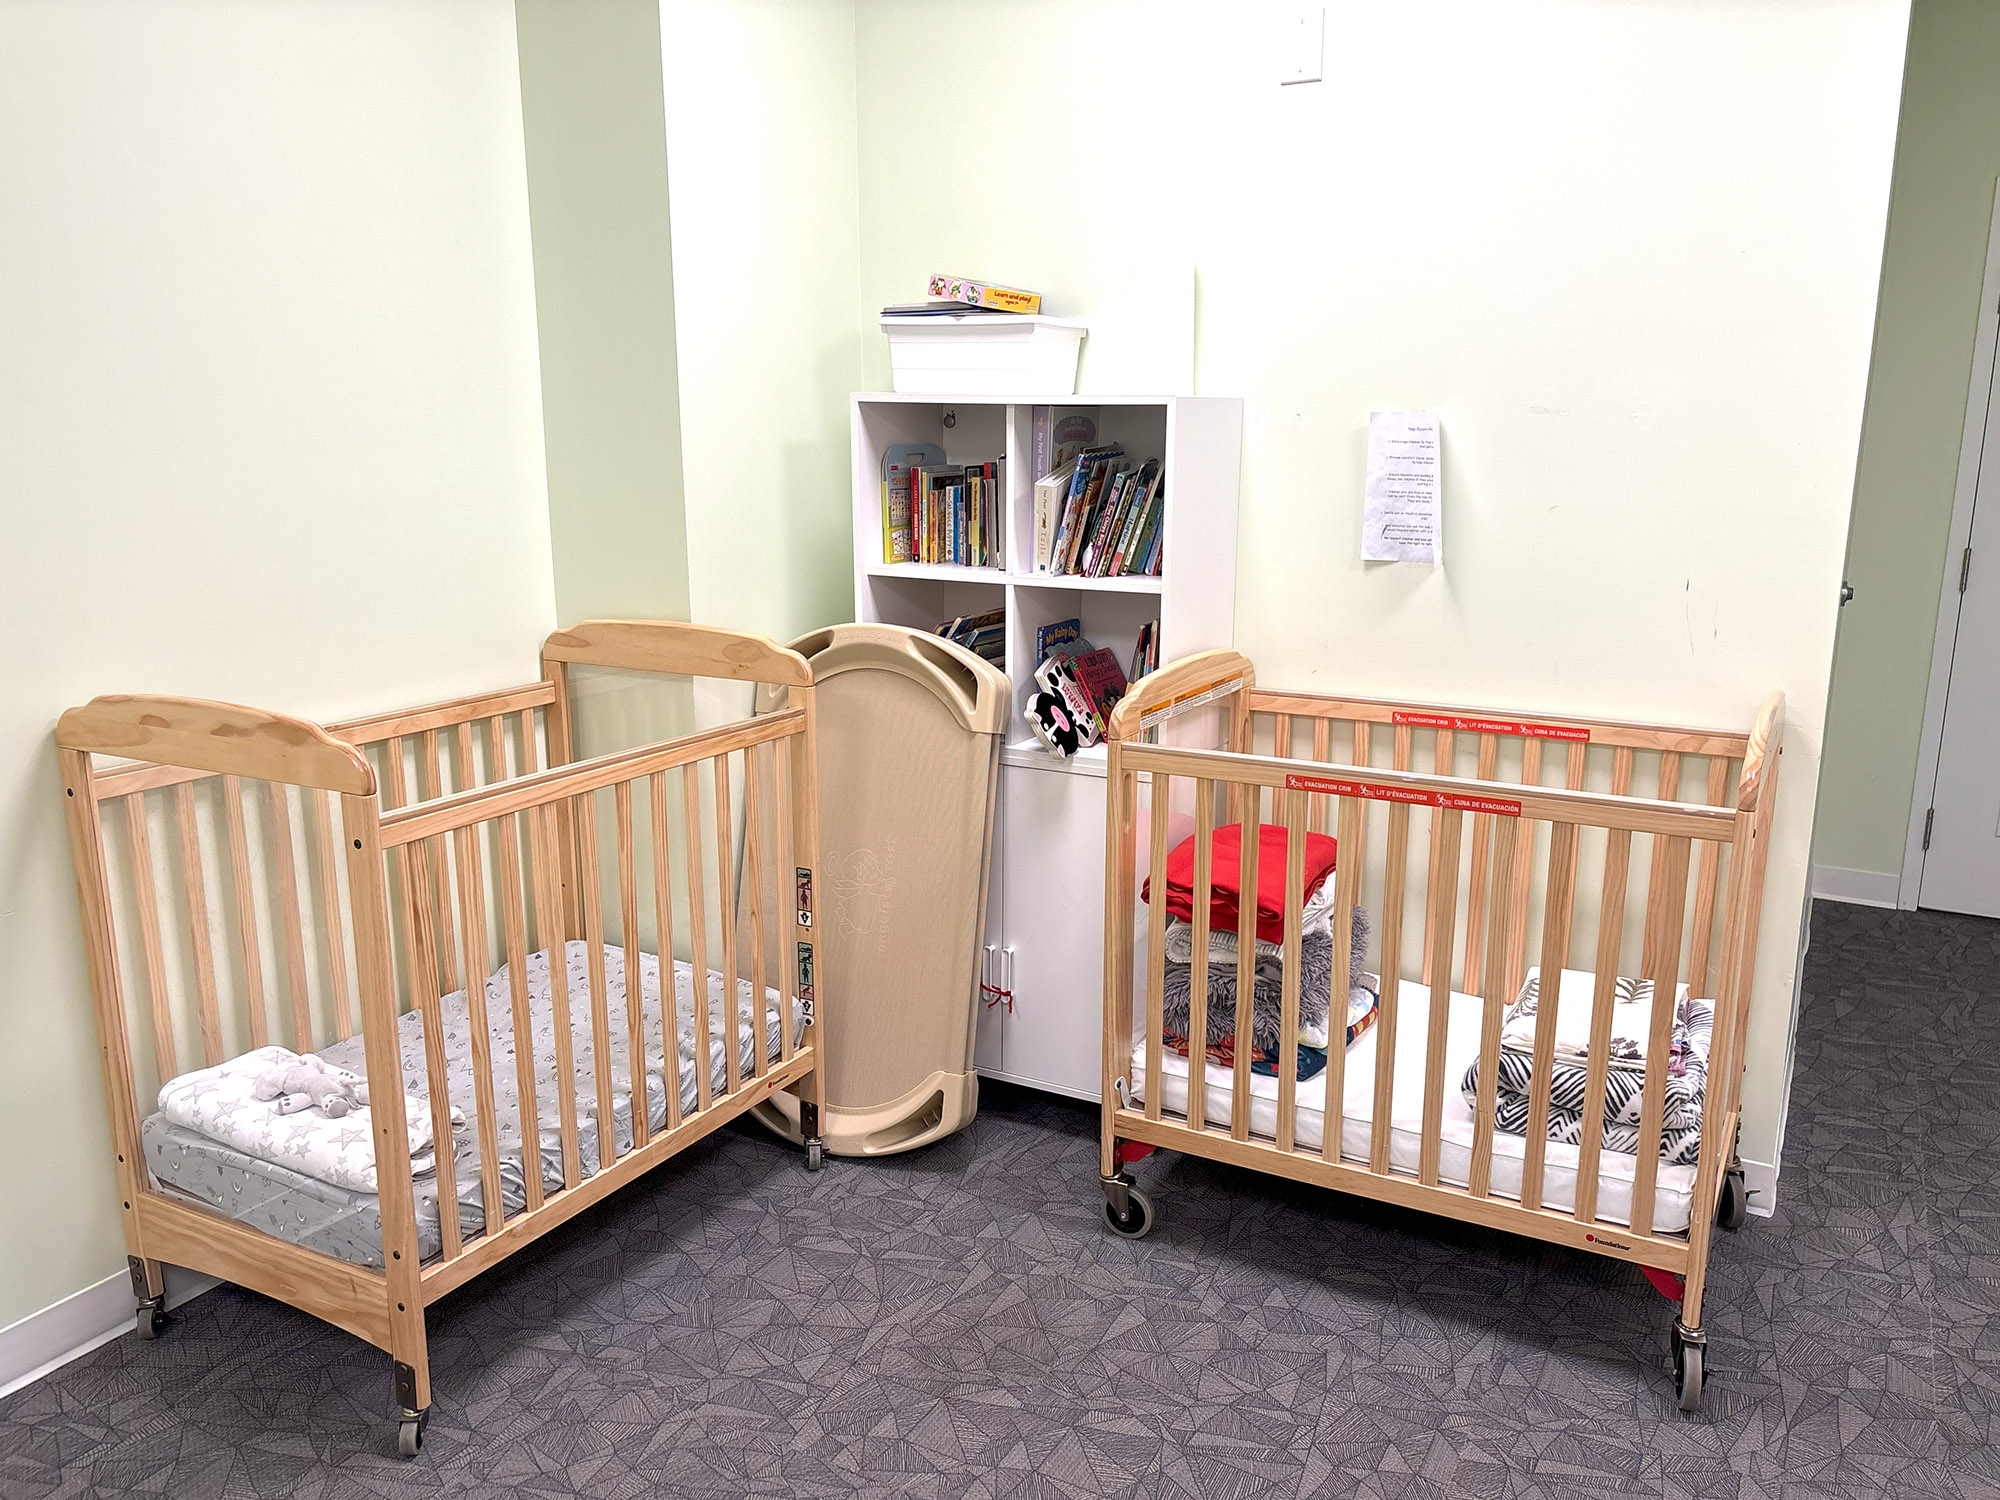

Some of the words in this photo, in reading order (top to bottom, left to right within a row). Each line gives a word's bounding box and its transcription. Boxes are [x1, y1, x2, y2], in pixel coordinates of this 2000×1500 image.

[1018, 294, 1031, 304] play!
[1037, 432, 1043, 440] My
[1046, 632, 1054, 645] My
[1054, 626, 1068, 640] Rainy
[1068, 626, 1078, 640] Day
[1478, 722, 1512, 731] D'ÉVACUATION
[1556, 730, 1588, 739] EVACUACIÓN
[1304, 781, 1337, 791] EVACUATION
[1338, 784, 1351, 792] CRIB
[1386, 789, 1427, 801] D'ÉVACUATION
[1454, 799, 1470, 807] CUNA
[1480, 802, 1519, 812] EVACUACIÓN
